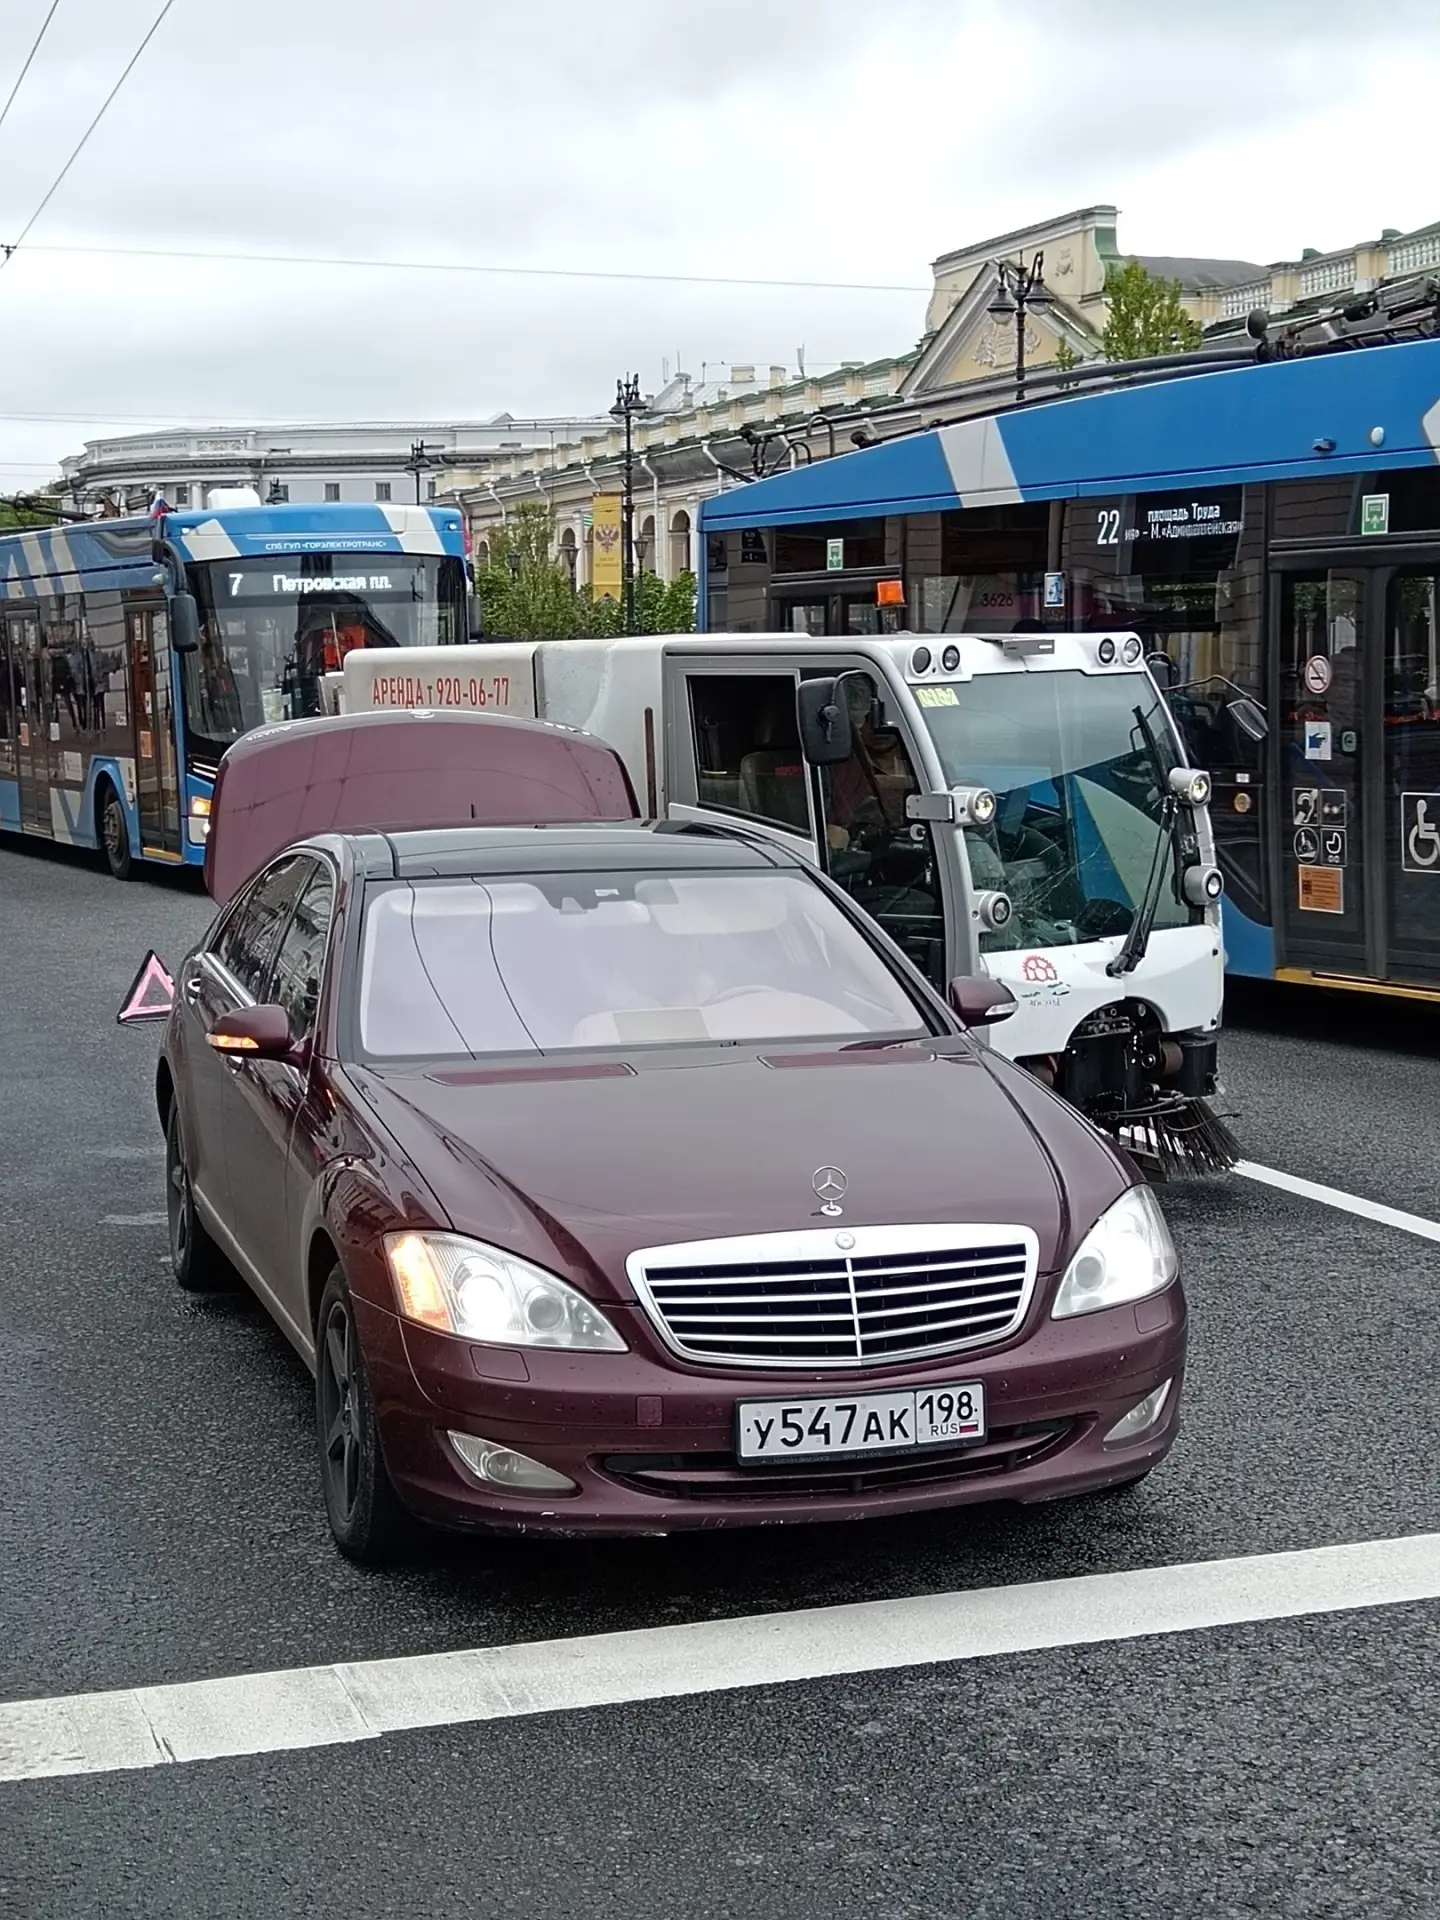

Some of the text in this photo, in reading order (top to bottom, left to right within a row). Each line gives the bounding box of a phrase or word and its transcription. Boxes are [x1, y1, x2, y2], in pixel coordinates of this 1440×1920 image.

[1148, 503, 1221, 523] площадь Труда
[1097, 510, 1120, 545] 22
[283, 542, 301, 550] ГУП
[228, 574, 392, 596] 7 Петровская пл.
[982, 592, 1013, 607] 3626
[373, 677, 424, 709] АРЕНДА
[436, 678, 509, 706] 920-06-77
[753, 1391, 974, 1449] У547АК 198
[930, 1422, 959, 1437] RUS
